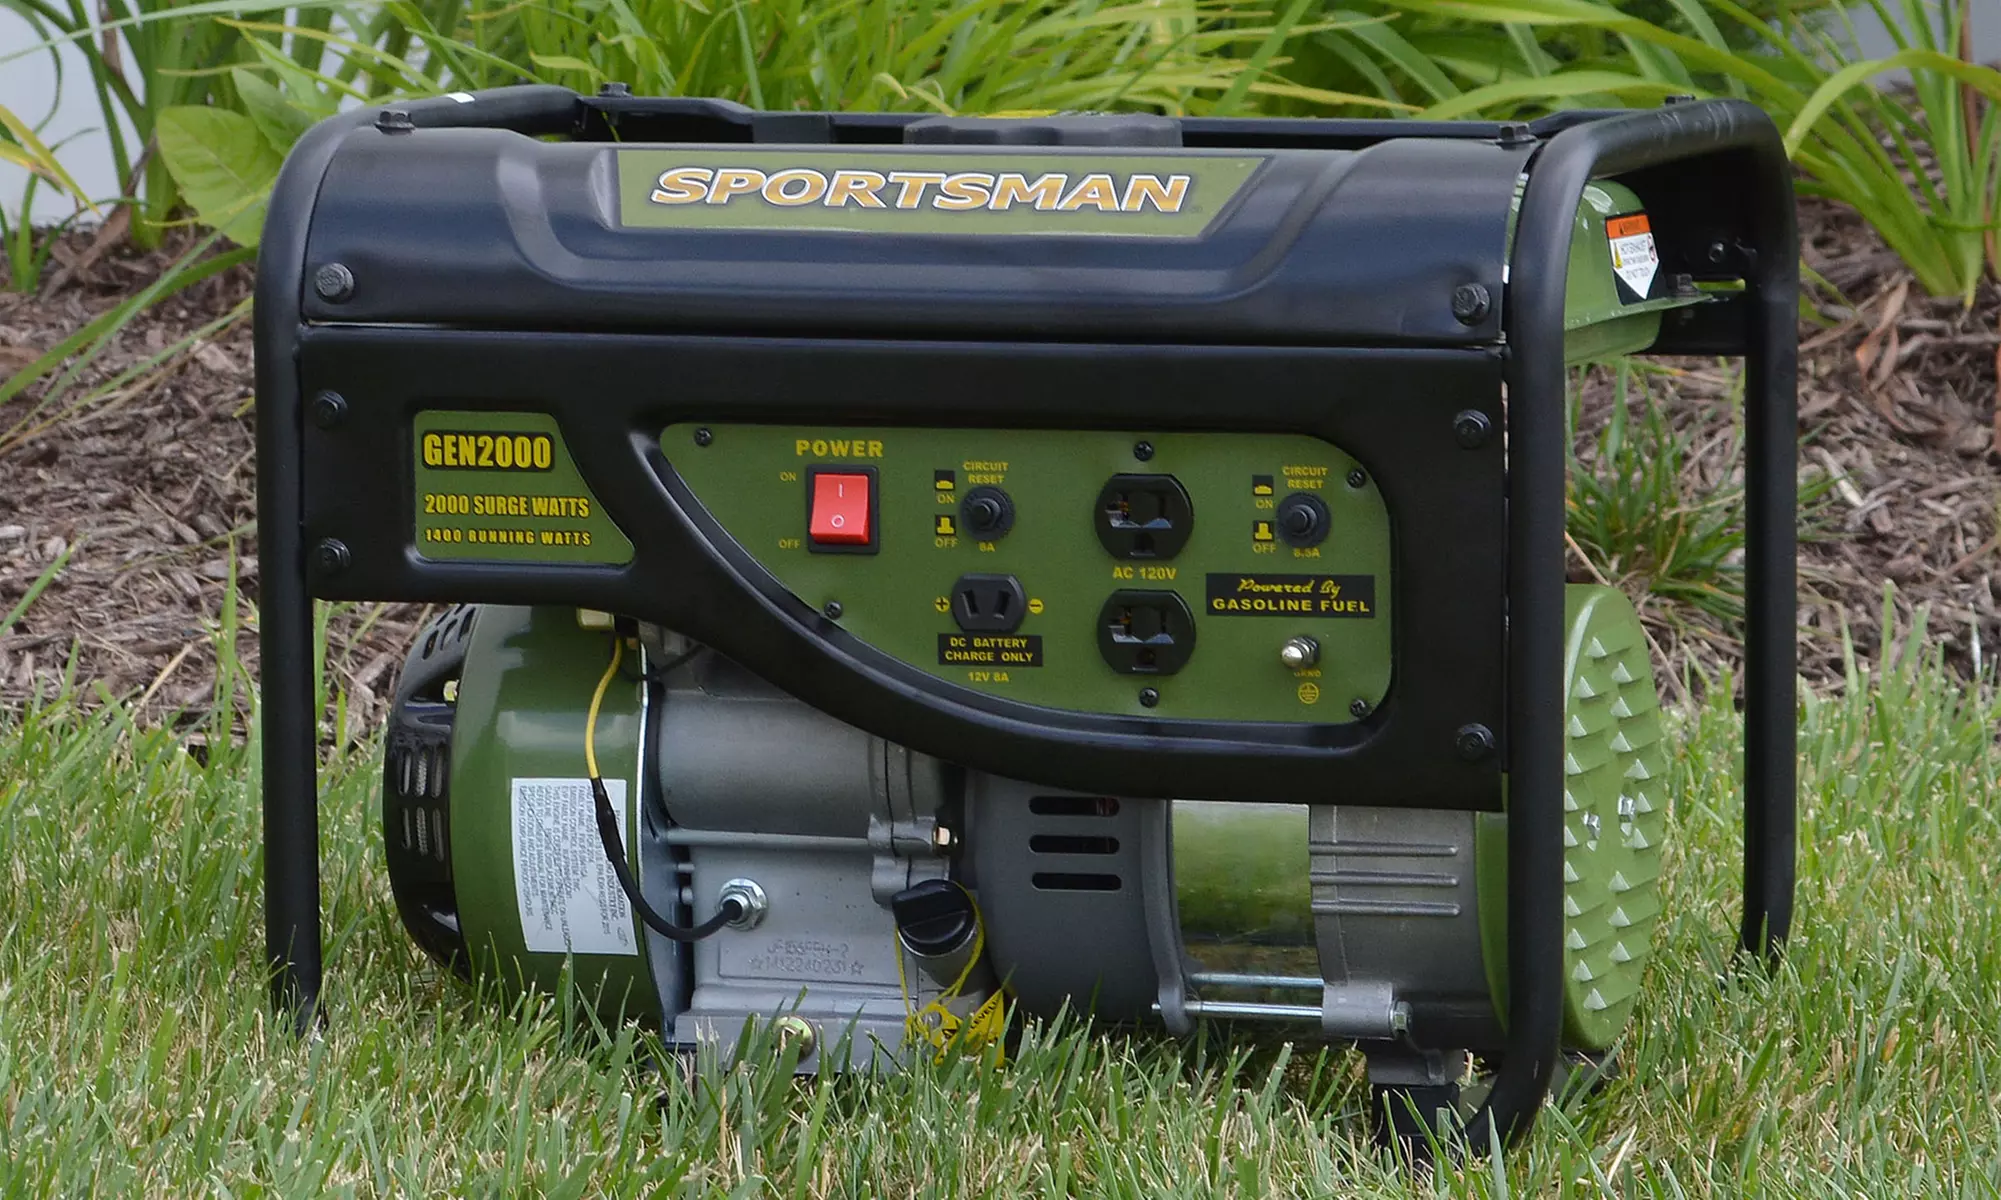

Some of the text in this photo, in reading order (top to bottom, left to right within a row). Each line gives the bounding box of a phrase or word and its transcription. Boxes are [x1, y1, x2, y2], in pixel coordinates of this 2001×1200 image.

[651, 168, 1191, 212] SPORTSMAN
[423, 434, 552, 469] GEN2000
[796, 440, 884, 458] POWER
[962, 461, 1009, 472] CIRCUIT
[1281, 465, 1329, 477] CIRCUIT
[779, 471, 797, 482] ON
[967, 474, 1005, 484] RESET
[1287, 479, 1324, 490] RESET
[936, 493, 955, 504] ON
[1255, 499, 1274, 510] ON
[424, 494, 590, 518] 2000 SURGE WATTS
[425, 528, 592, 547] 1400 RUNNING WATTS
[935, 538, 958, 549] OFF
[778, 538, 800, 550] OFF
[1252, 543, 1277, 554] OFF
[1112, 567, 1177, 581] AC 120V
[1236, 579, 1341, 599] Powered By
[1212, 598, 1370, 613] GASOLINE FUEL
[949, 637, 1029, 650] DC BATTERY
[944, 650, 1034, 663] CHARGE ONLY
[967, 672, 990, 683] 12V
